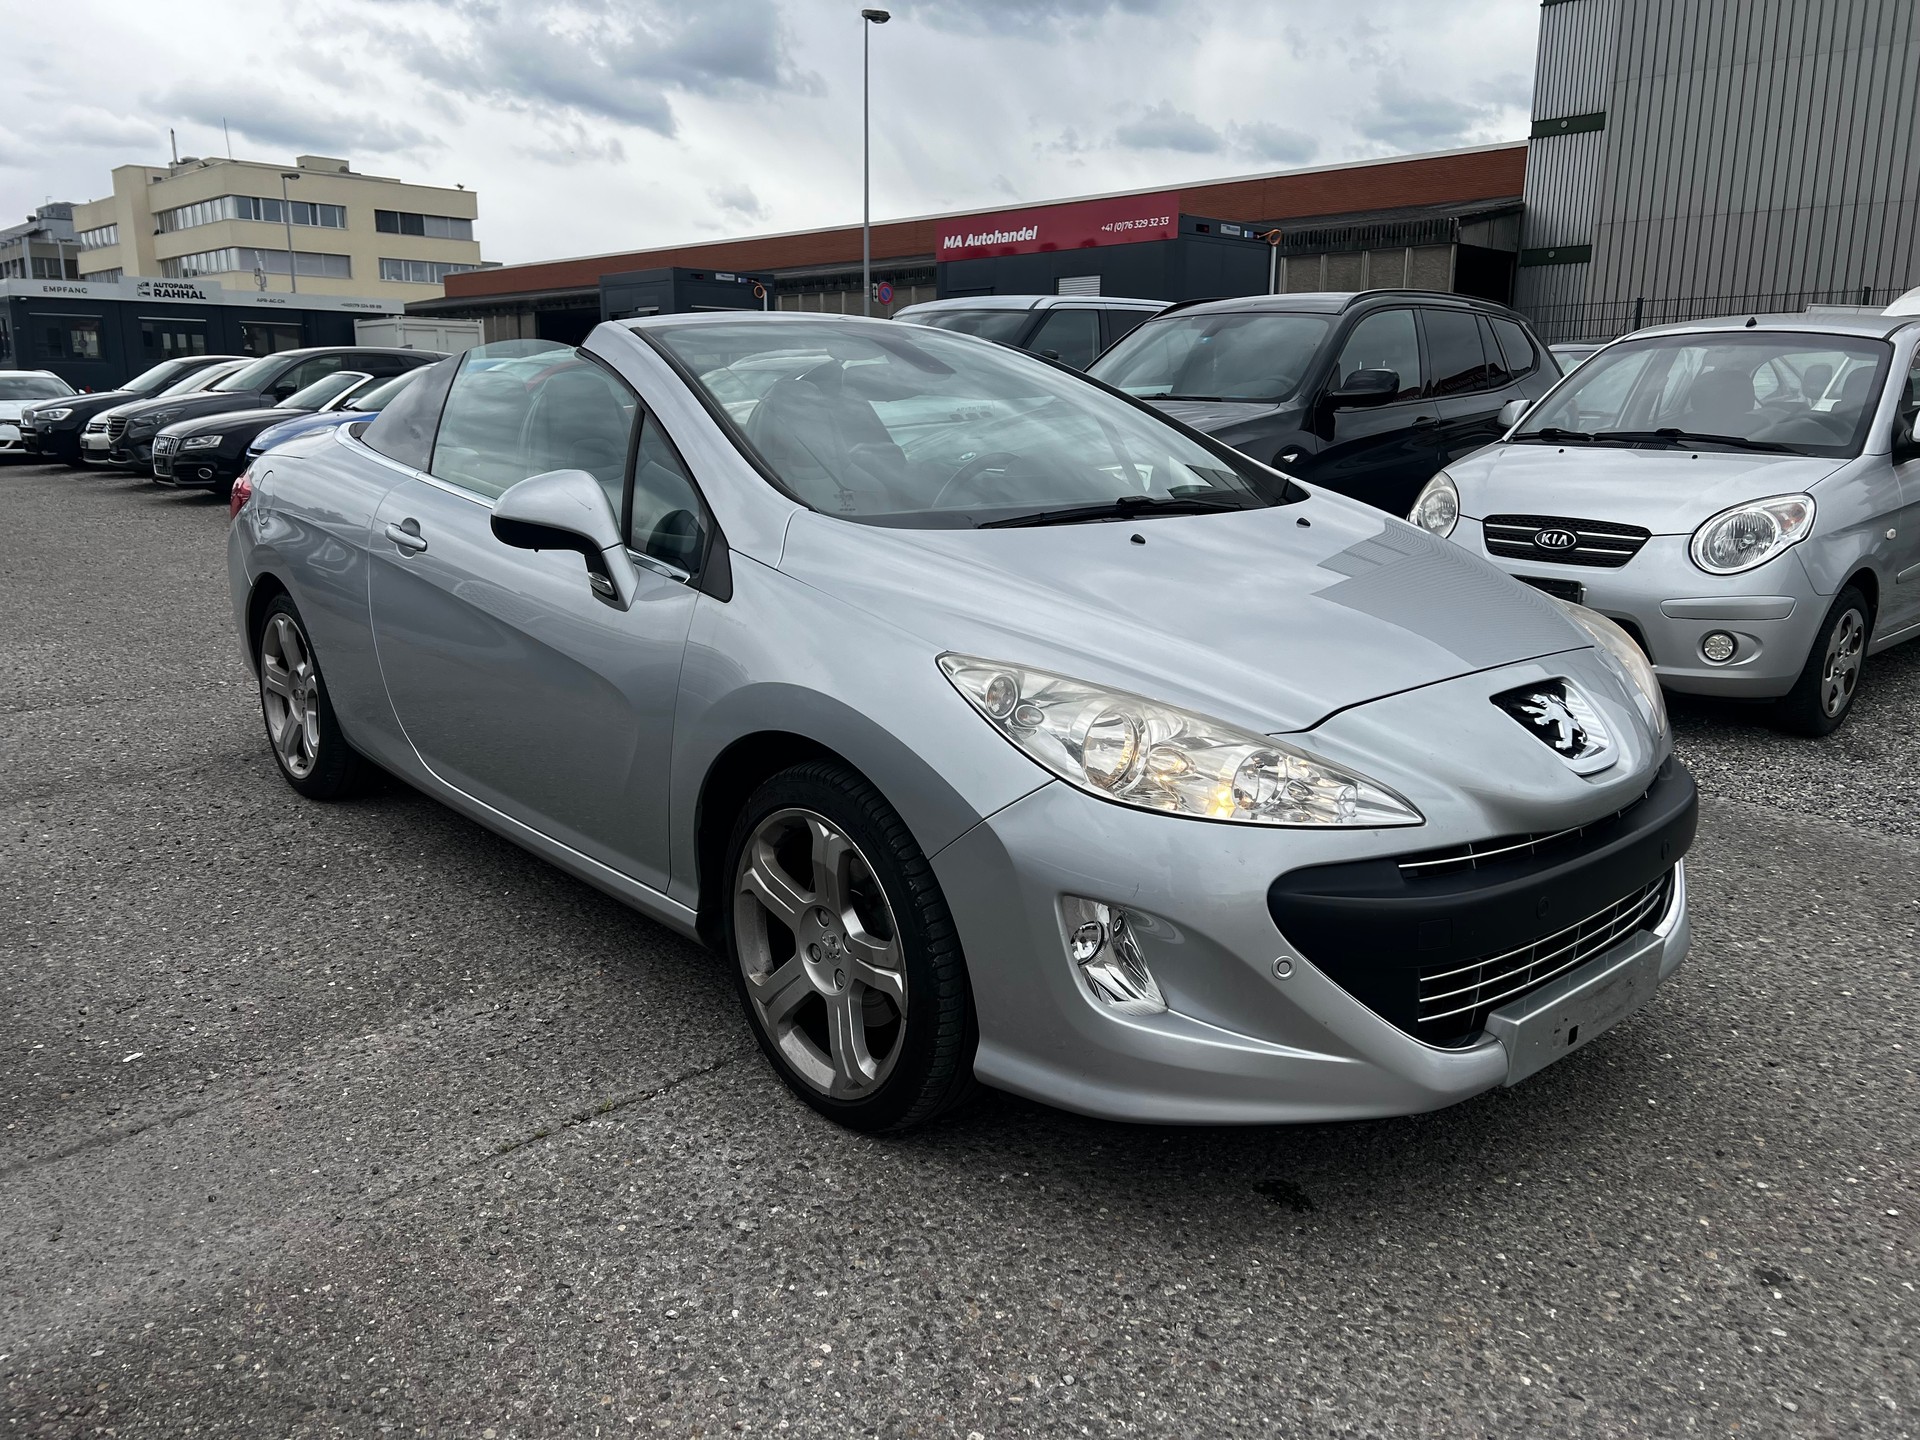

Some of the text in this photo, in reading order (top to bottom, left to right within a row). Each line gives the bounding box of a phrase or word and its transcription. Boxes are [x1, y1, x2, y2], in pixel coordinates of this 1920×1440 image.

[1101, 216, 1170, 232] +41 (0)76 329 32 33
[943, 225, 1038, 249] MA Autohandel
[43, 286, 88, 294] EMPFANG
[153, 282, 195, 290] AUTOPARK
[153, 288, 207, 300] RAHHAL
[1541, 533, 1568, 546] KIA
